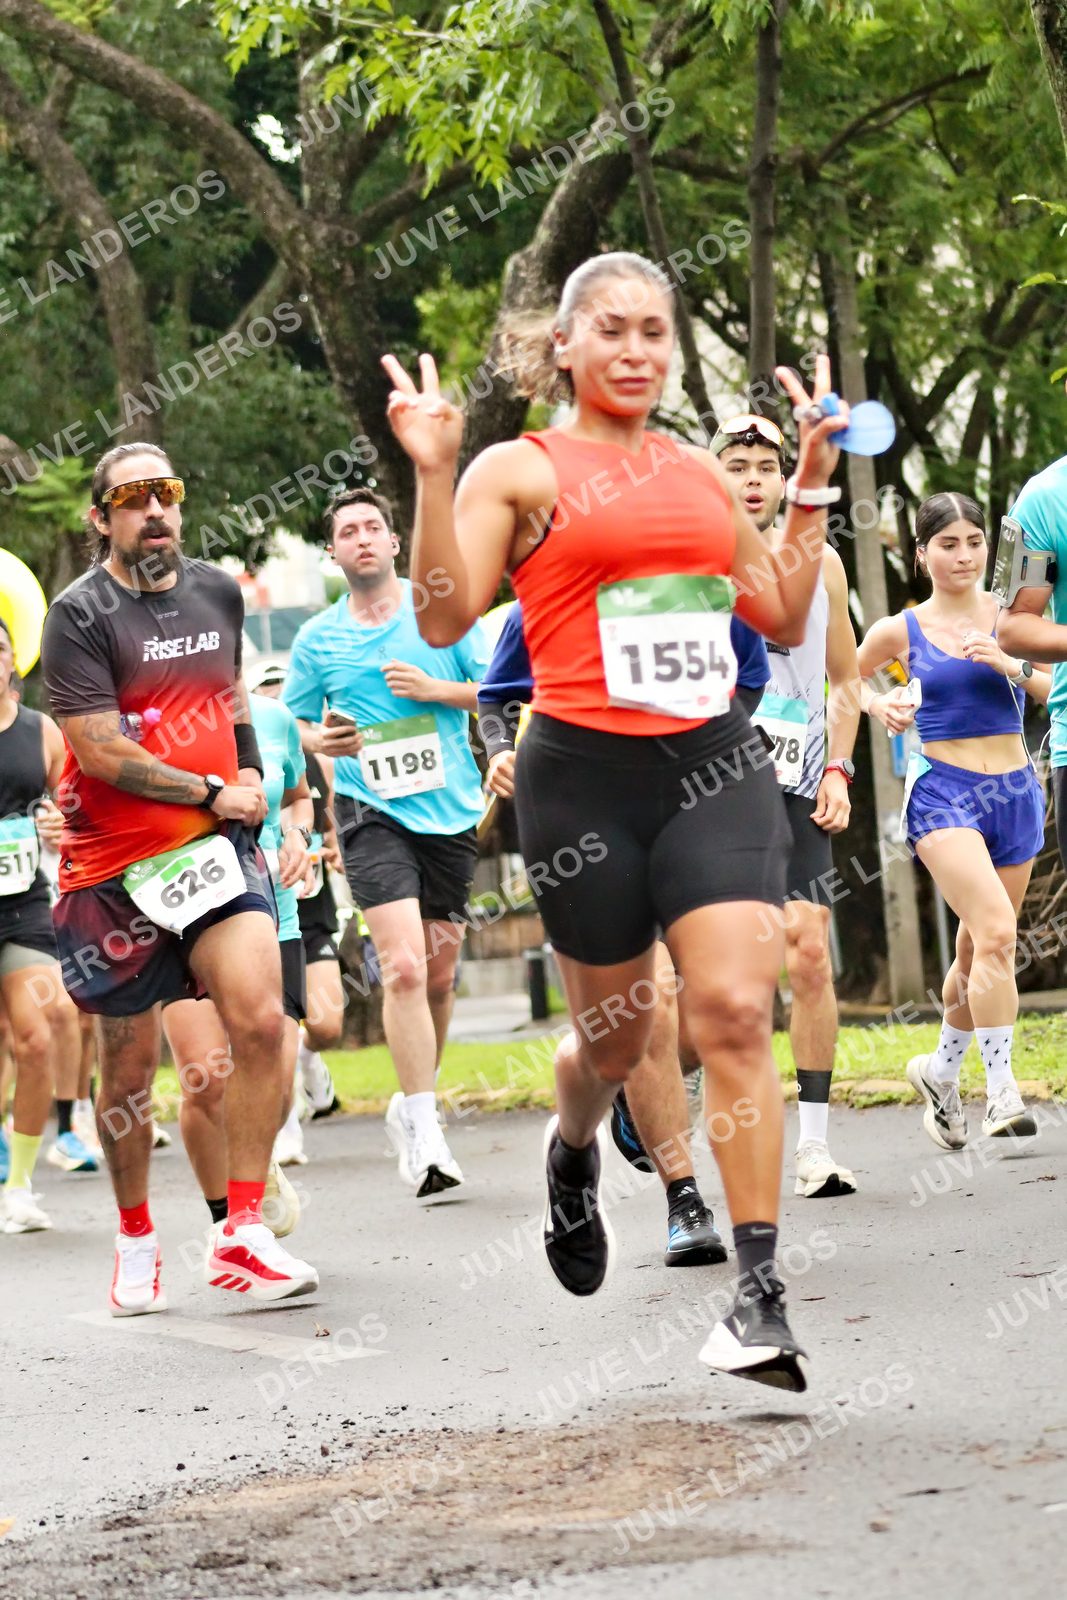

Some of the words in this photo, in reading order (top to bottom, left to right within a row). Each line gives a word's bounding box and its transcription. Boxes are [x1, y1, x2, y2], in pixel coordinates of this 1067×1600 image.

[143, 636, 184, 662] RISE
[185, 631, 220, 655] LAB
[621, 640, 729, 685] 1554
[368, 749, 437, 781] 1198
[768, 734, 800, 764] 78
[160, 857, 225, 909] 626
